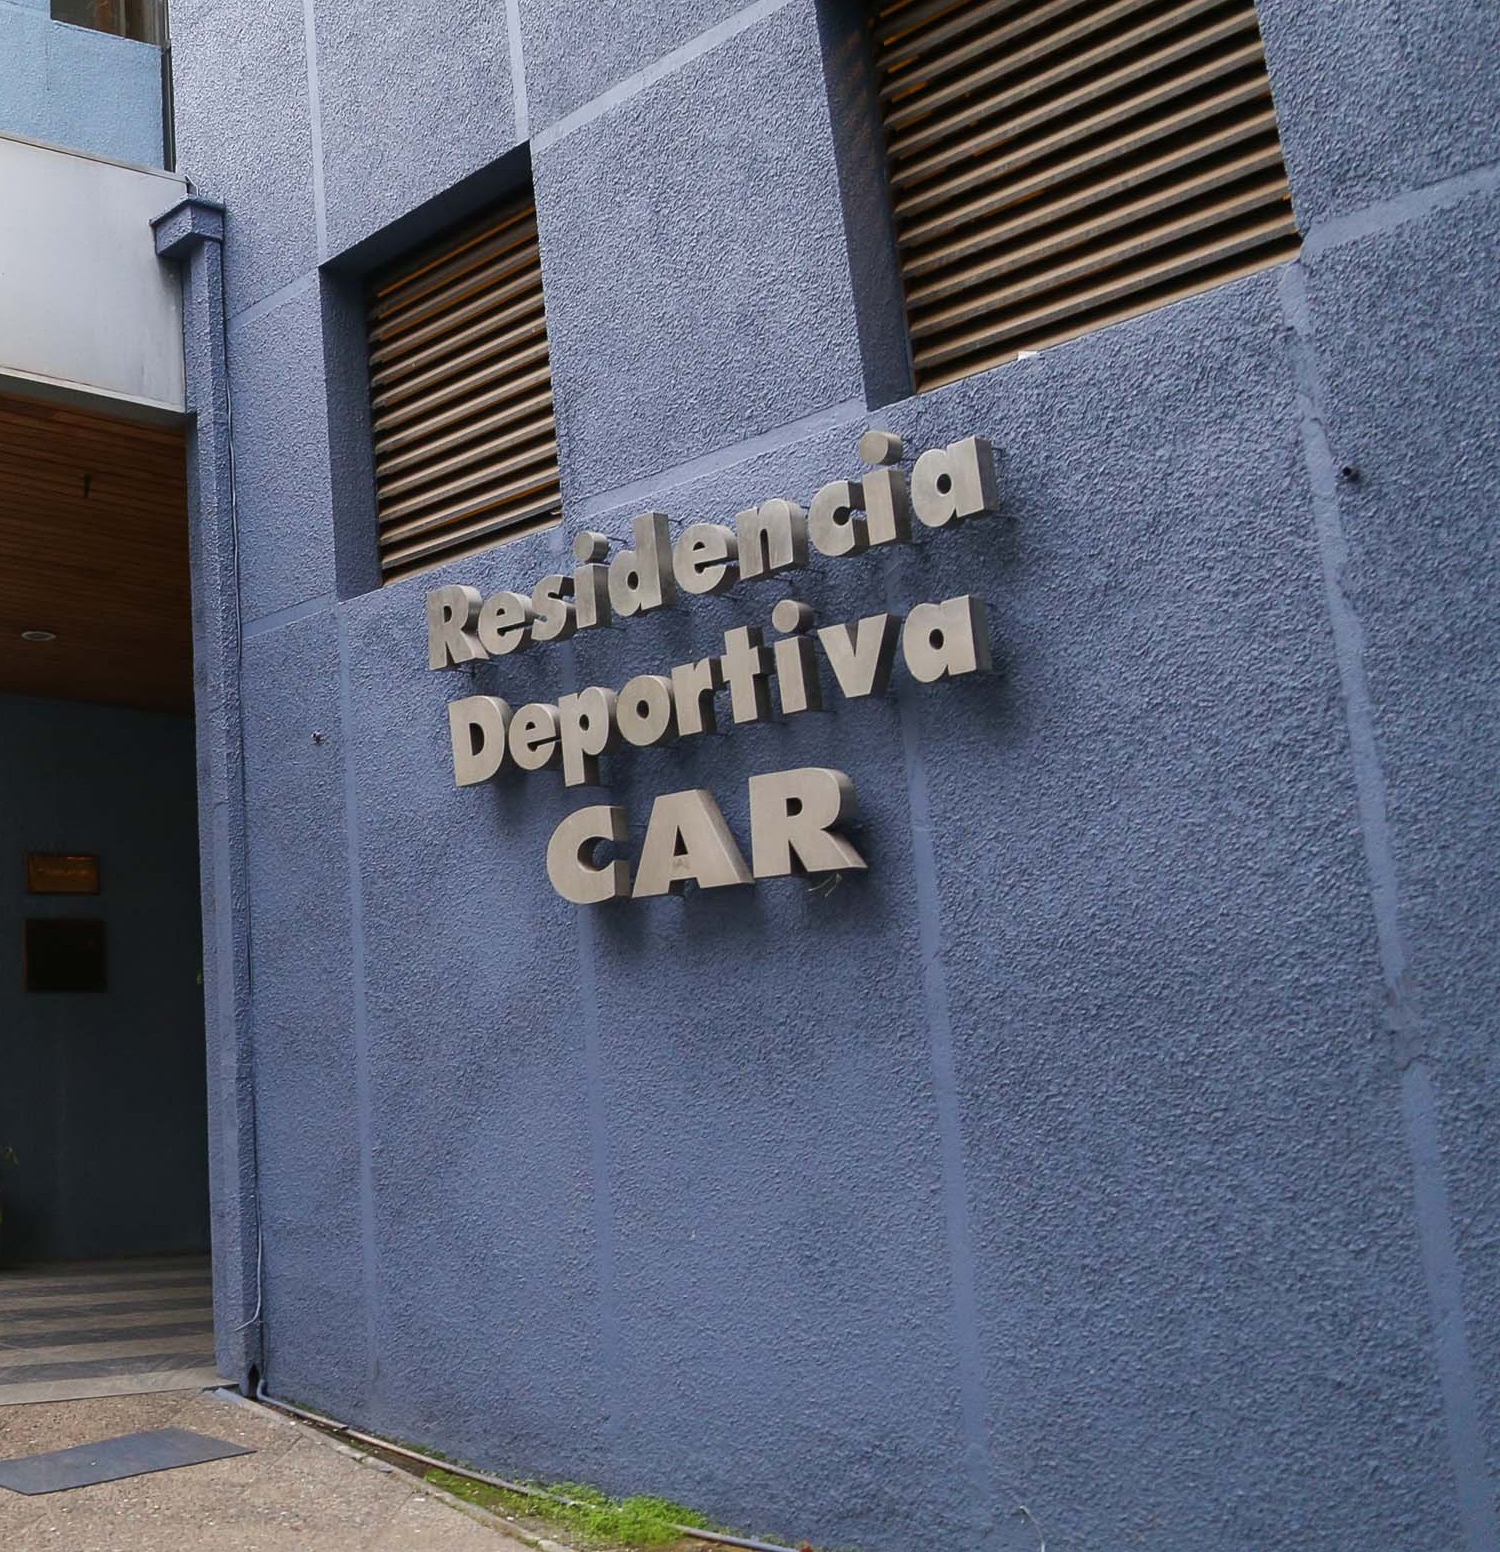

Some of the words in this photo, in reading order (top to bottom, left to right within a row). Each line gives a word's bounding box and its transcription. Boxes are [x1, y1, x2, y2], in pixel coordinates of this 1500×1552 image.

[427, 431, 996, 670] Residencia
[448, 595, 988, 787] Deportiva
[546, 767, 867, 904] CAR
